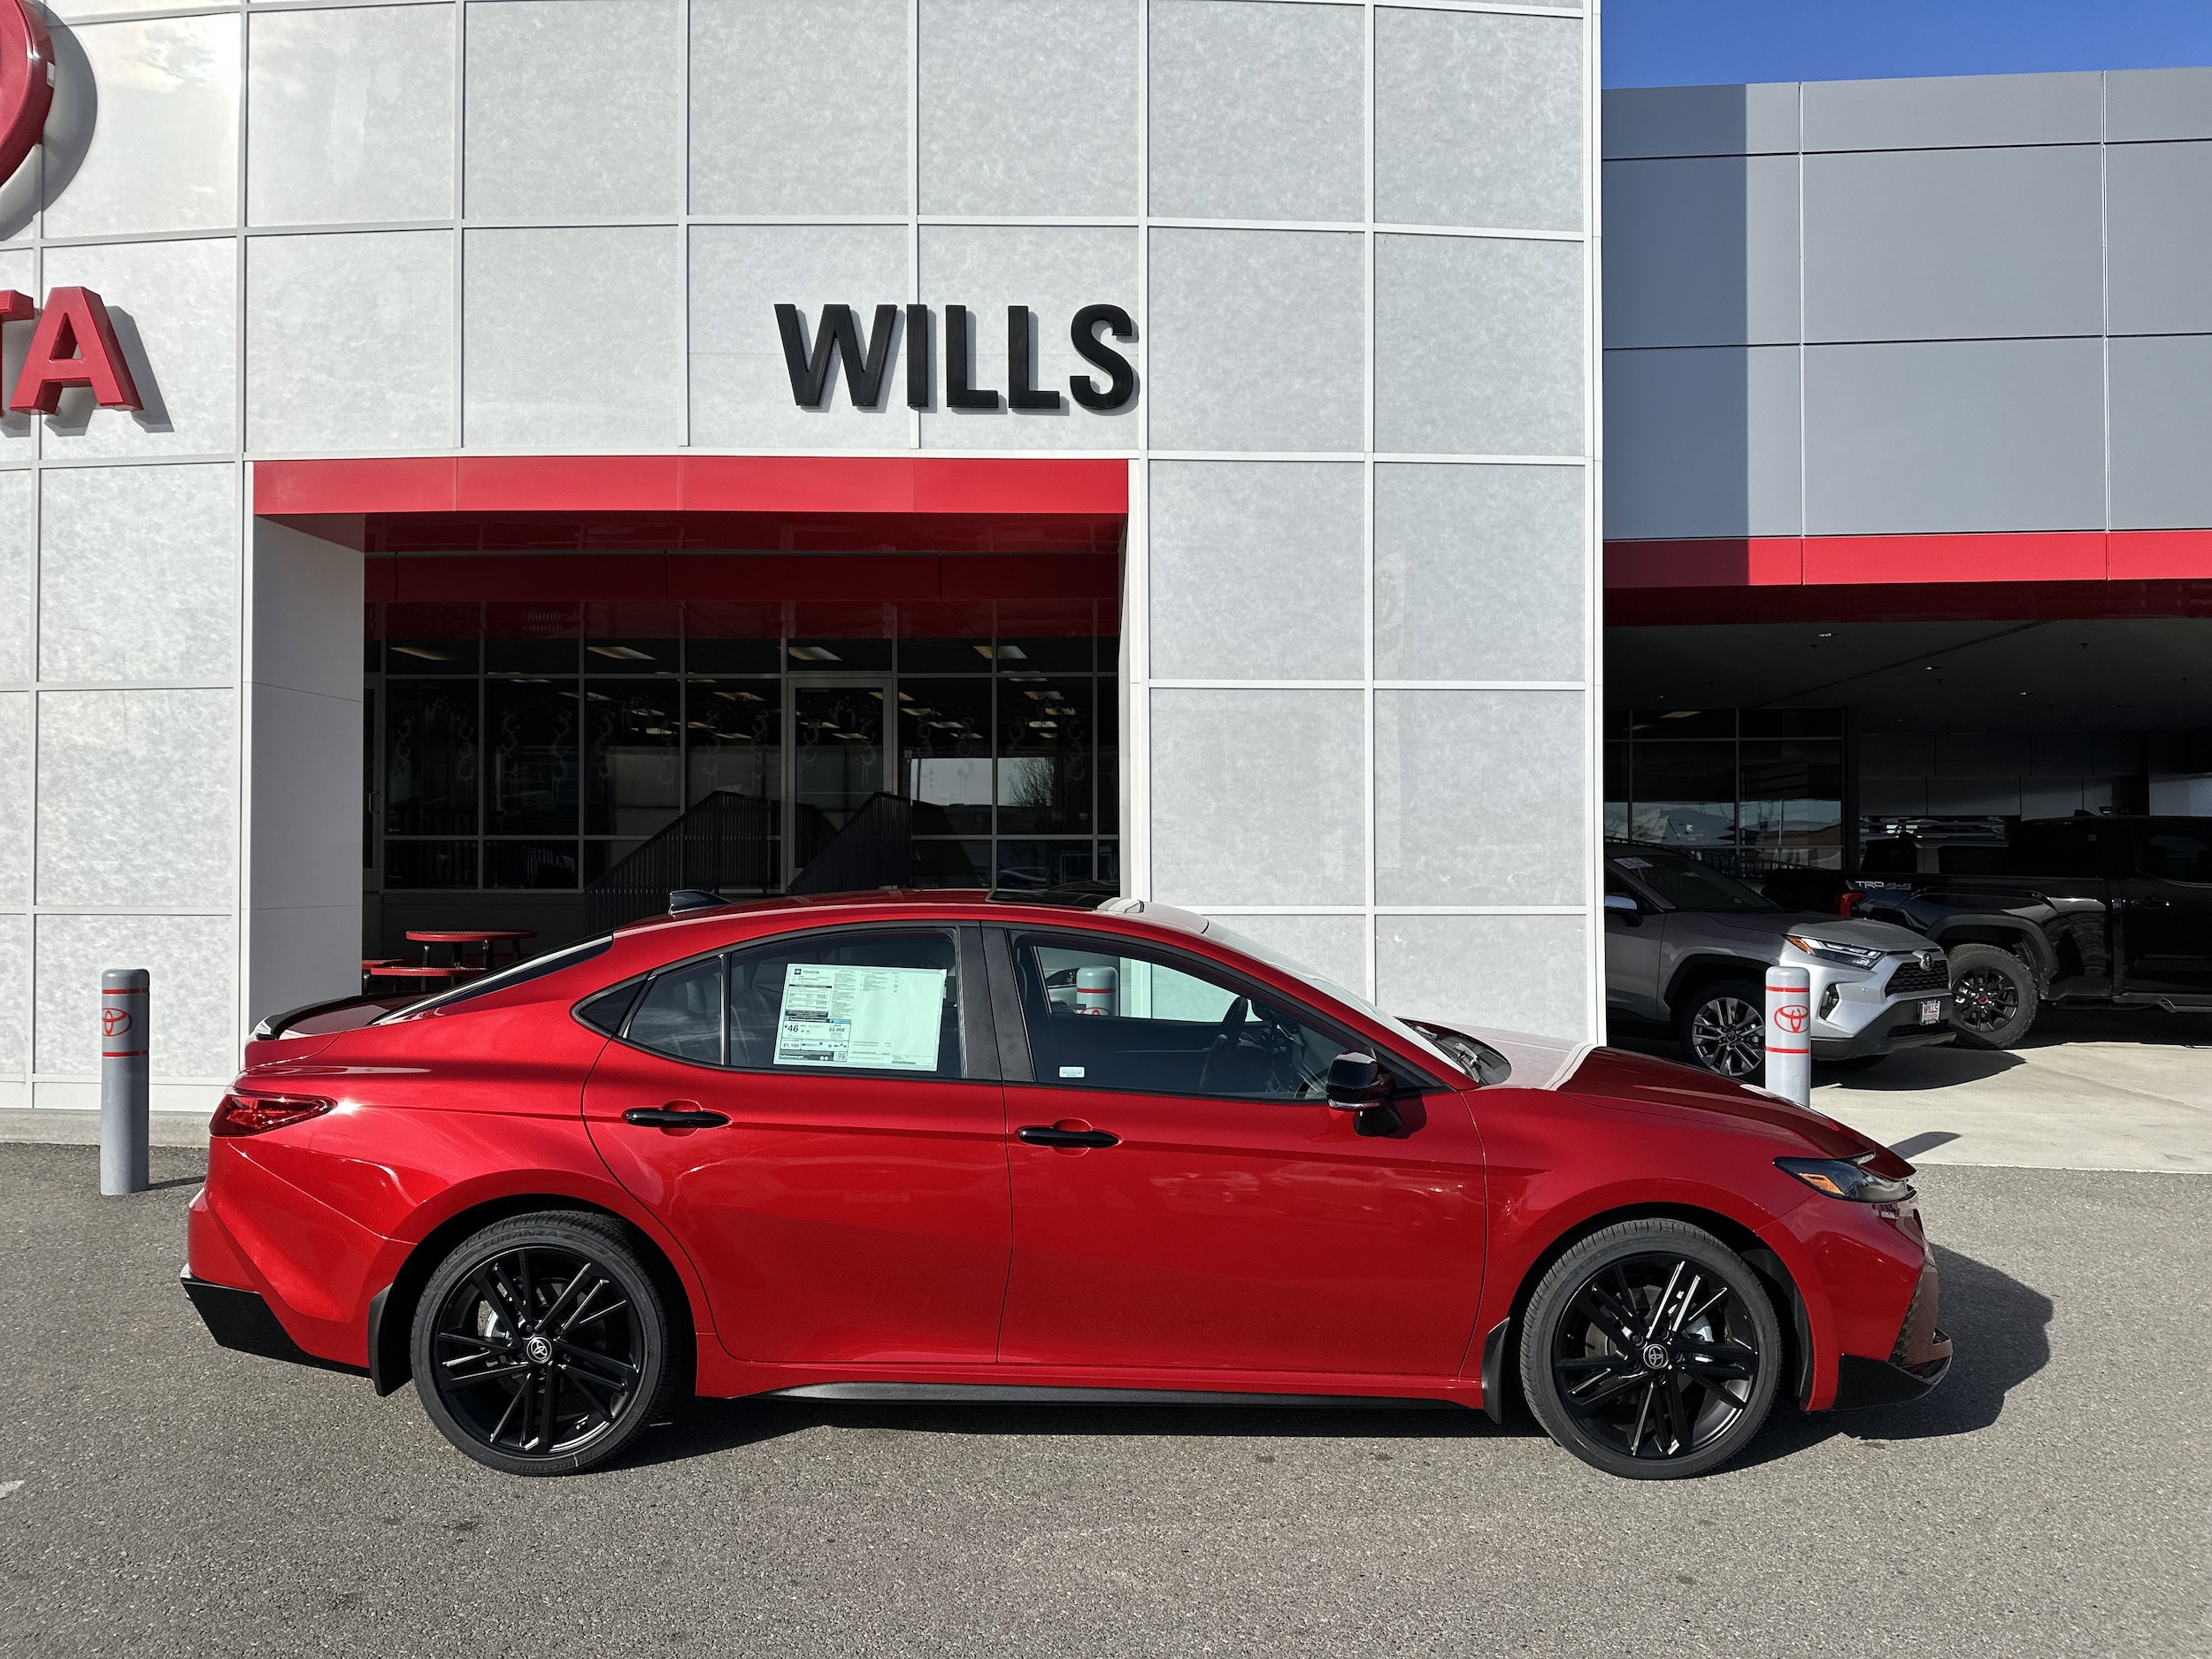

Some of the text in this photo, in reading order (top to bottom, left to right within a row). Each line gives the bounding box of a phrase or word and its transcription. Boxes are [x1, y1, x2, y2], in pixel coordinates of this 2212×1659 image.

[773, 303, 1134, 410] WILLS
[1855, 880, 1885, 889] TRD
[1924, 1004, 1939, 1014] WILLS
[480, 1230, 558, 1249] TURANZA
